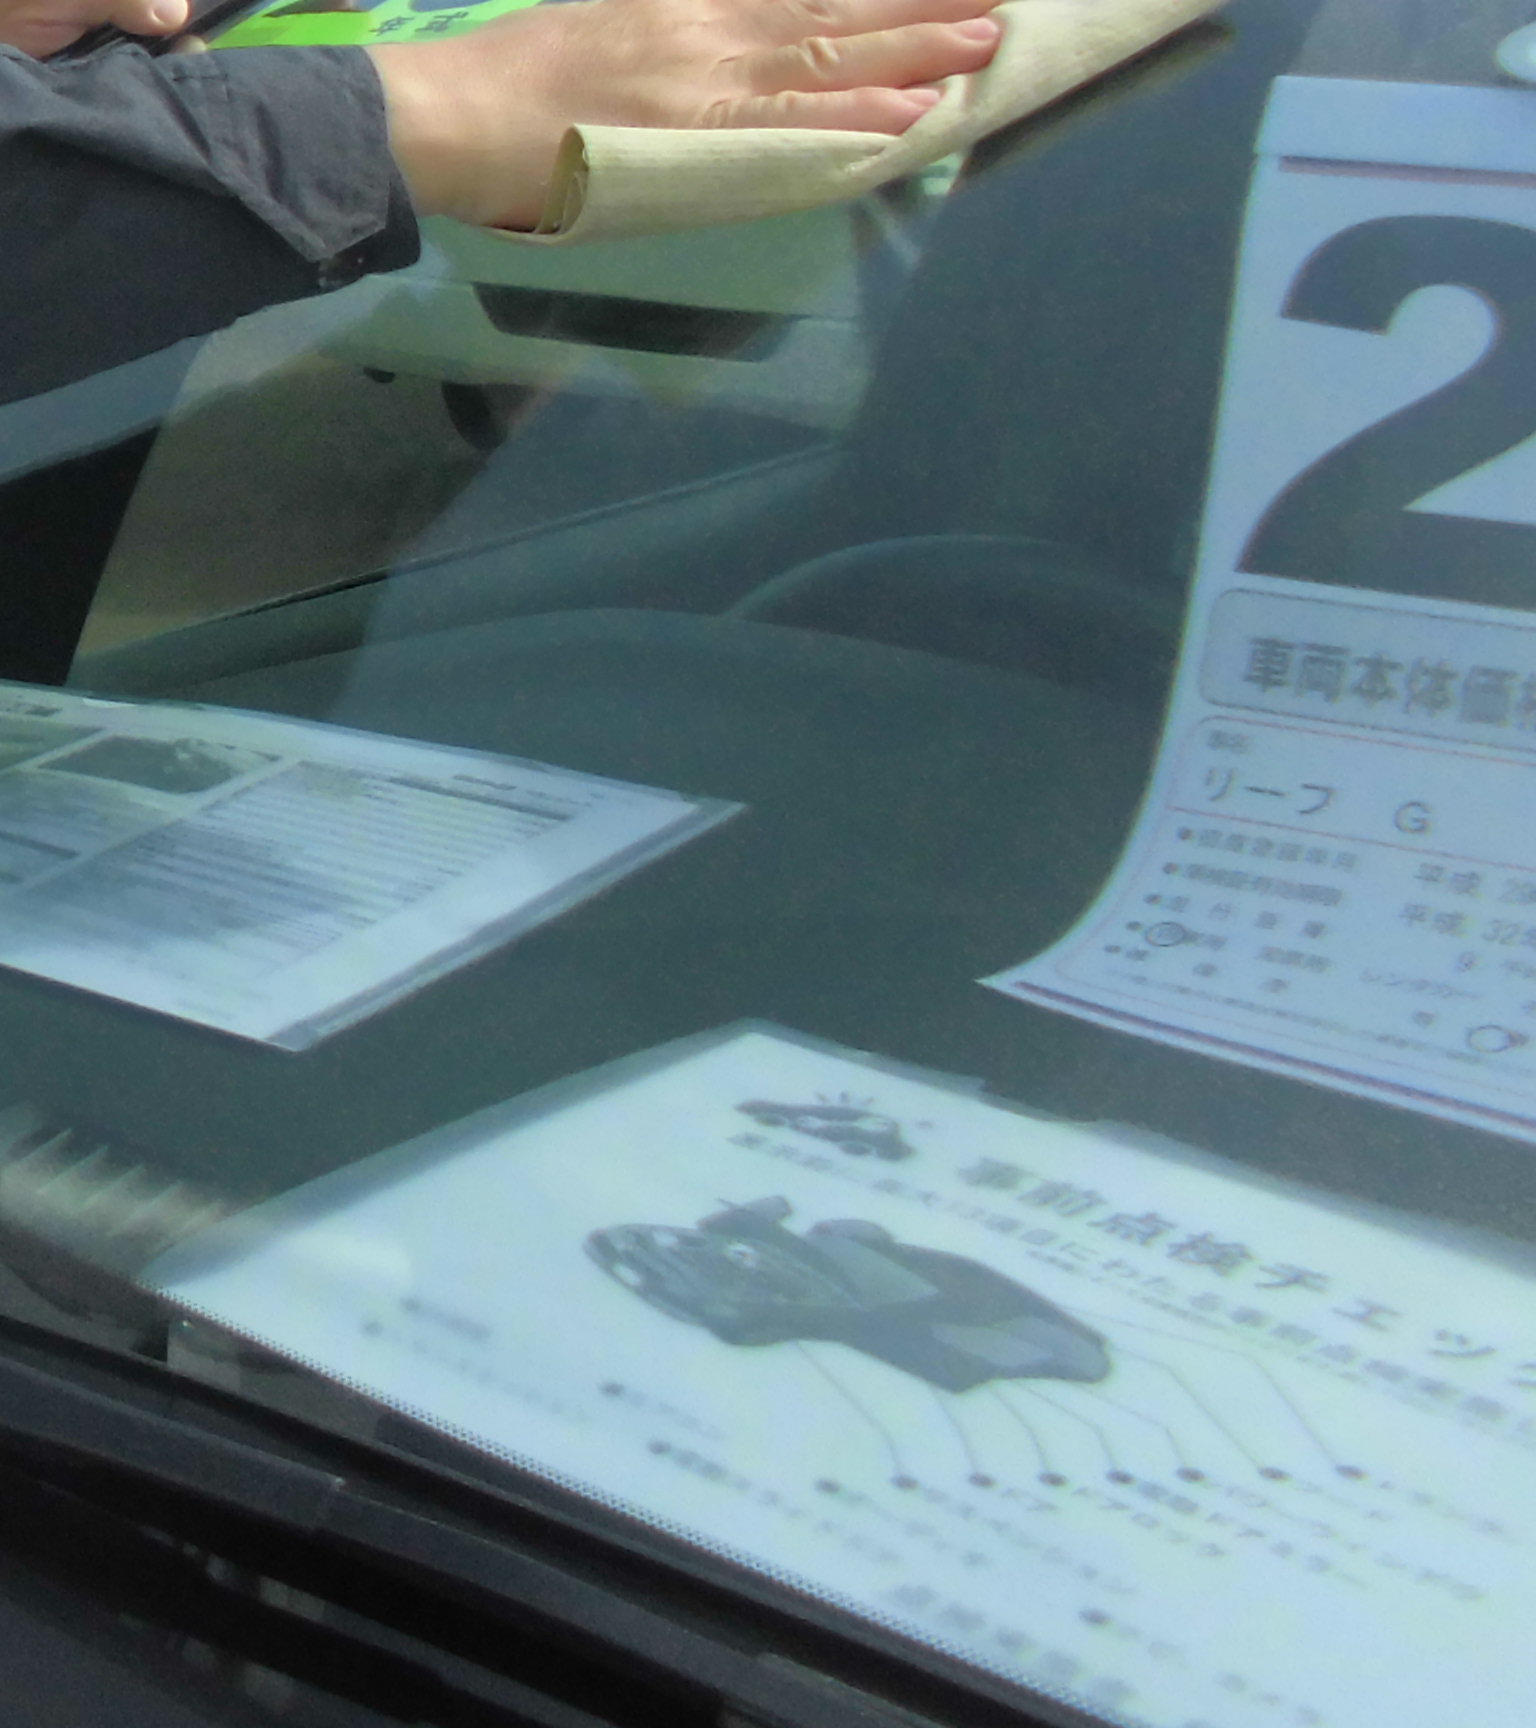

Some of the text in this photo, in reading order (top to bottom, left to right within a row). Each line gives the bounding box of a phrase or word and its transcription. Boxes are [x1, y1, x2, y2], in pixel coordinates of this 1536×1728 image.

[1205, 768, 1434, 835] リーフ G
